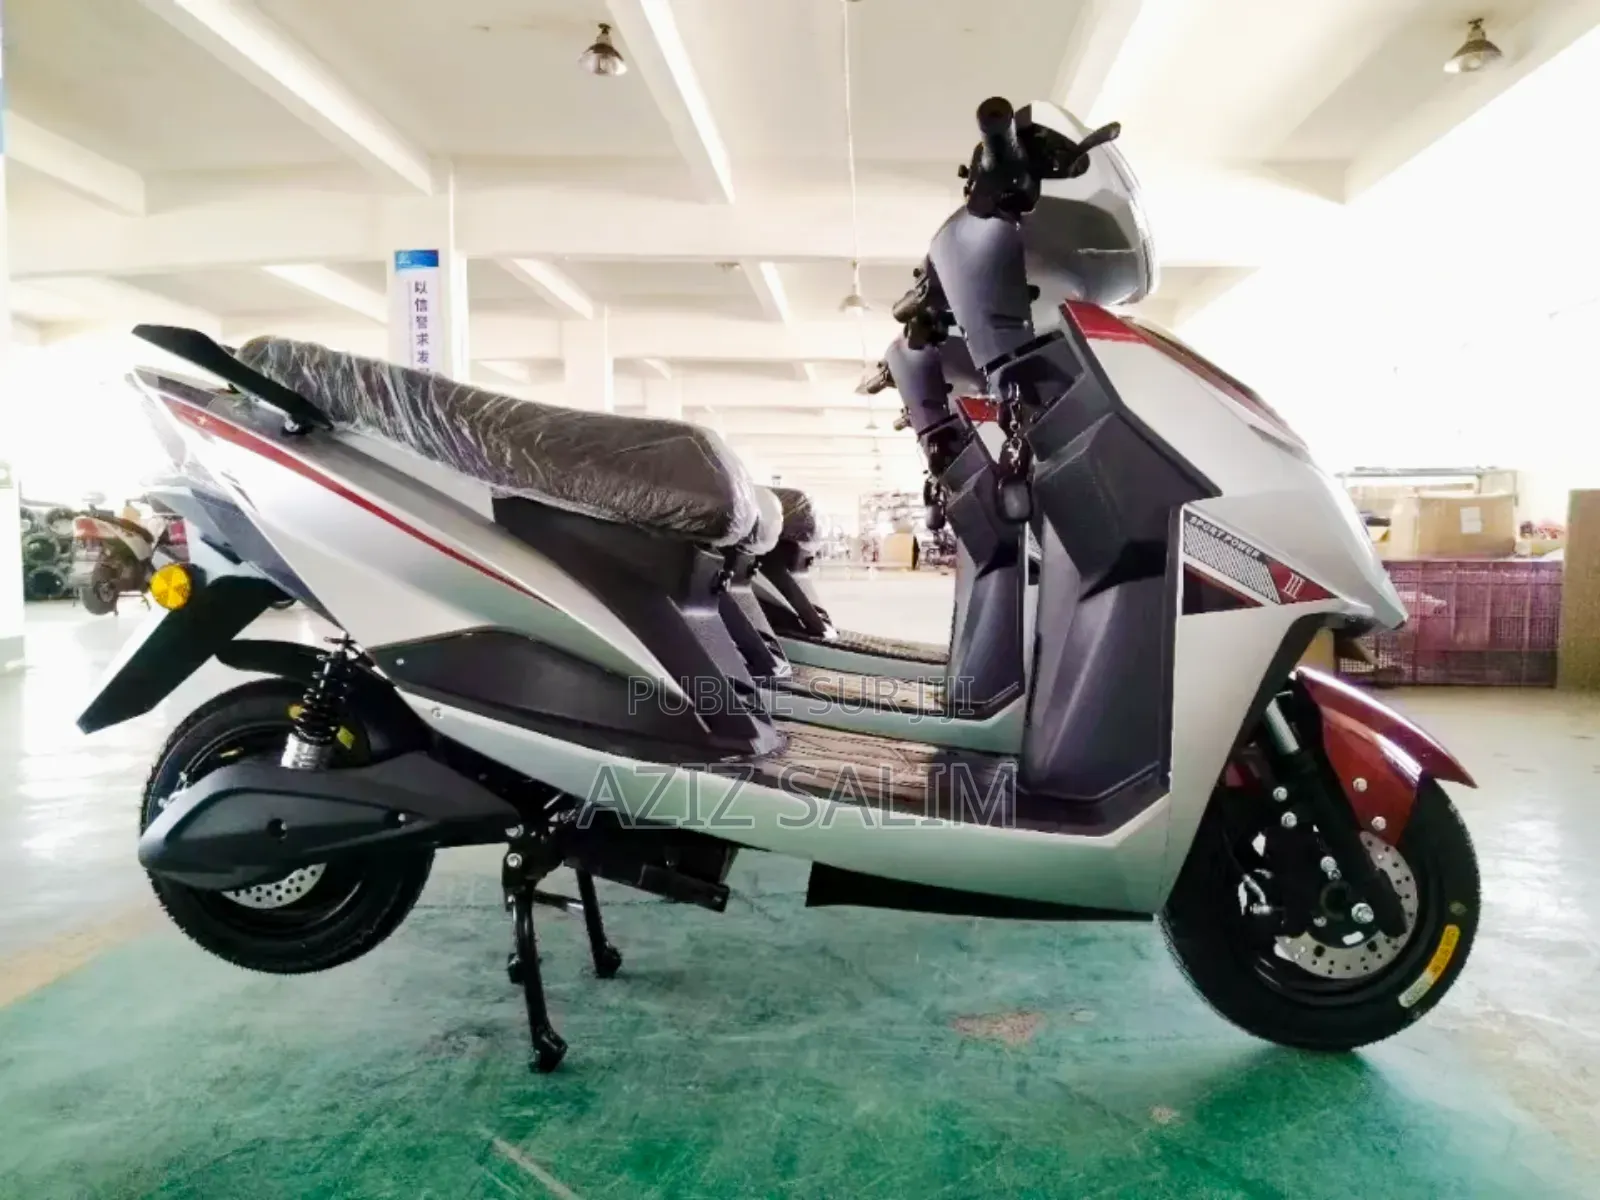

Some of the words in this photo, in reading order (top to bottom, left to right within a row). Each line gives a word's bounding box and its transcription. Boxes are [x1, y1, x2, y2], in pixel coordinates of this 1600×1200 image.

[414, 280, 429, 372] 以信誉求发
[1223, 535, 1260, 558] POWER
